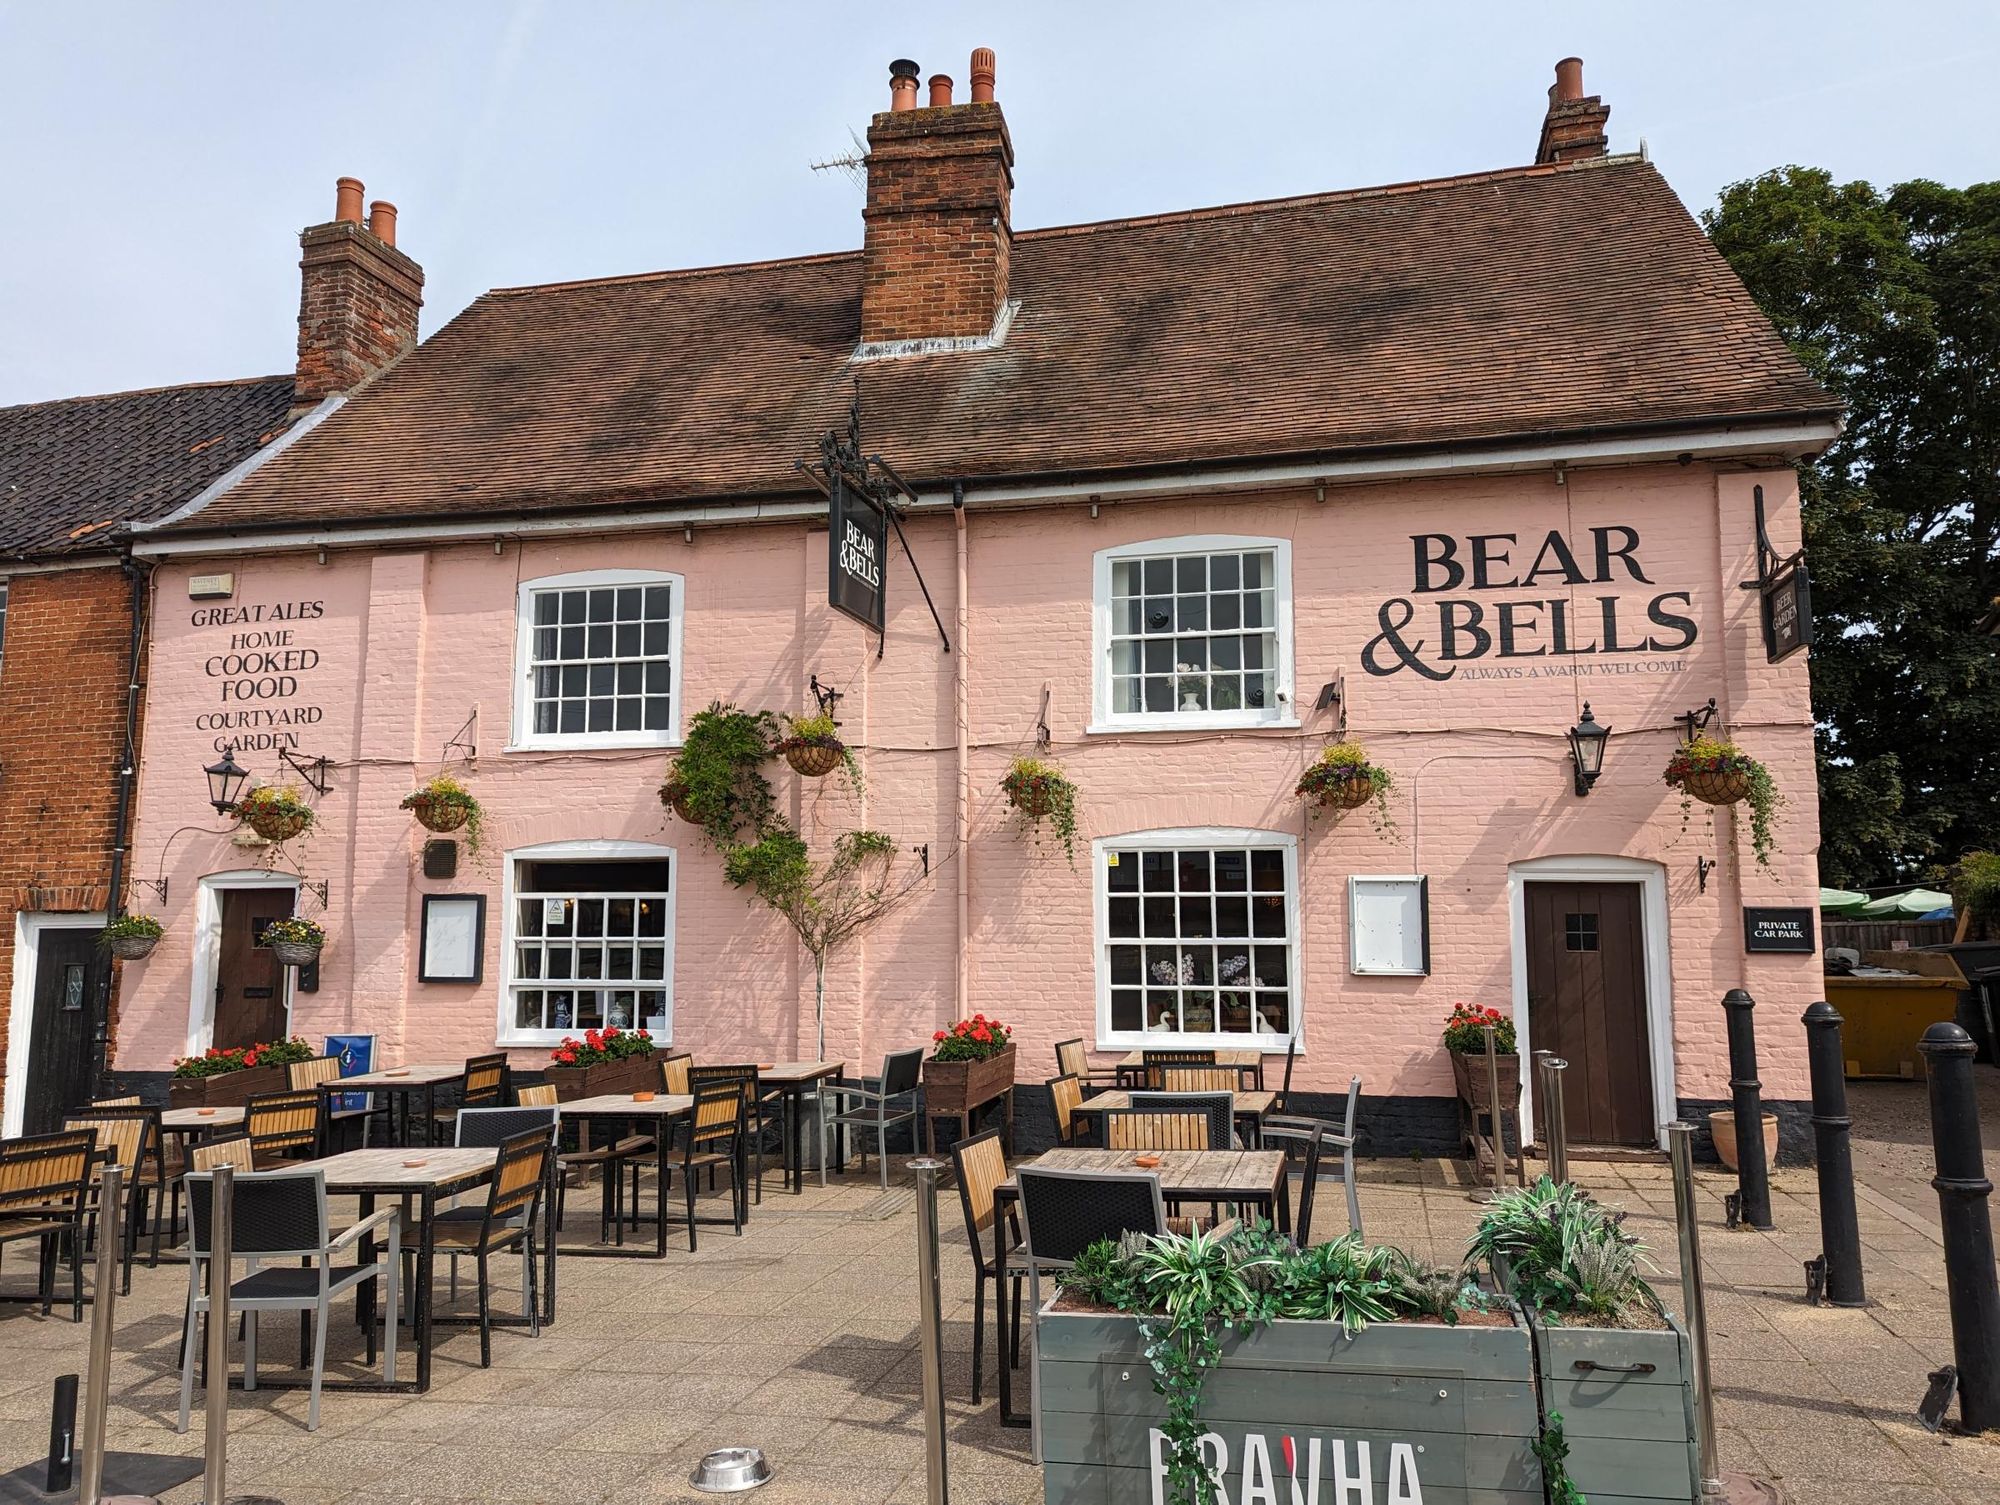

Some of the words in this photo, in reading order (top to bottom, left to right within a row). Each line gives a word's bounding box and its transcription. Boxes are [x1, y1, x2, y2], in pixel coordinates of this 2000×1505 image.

[846, 518, 876, 563] BEAR
[1408, 525, 1656, 594] BEAR
[191, 604, 267, 627] GREAT
[268, 600, 324, 621] ALES
[1776, 591, 1792, 612] BEER
[1773, 605, 1798, 631] GARDEN
[230, 629, 295, 650] HOME
[205, 649, 320, 677] COOKED
[1459, 667, 1524, 681] ALWAYS
[1526, 665, 1540, 679] A
[1542, 663, 1594, 677] WARM
[1599, 659, 1688, 676] WELCOME
[221, 676, 298, 702] FOOD
[195, 706, 323, 731] COURTYARD
[213, 731, 300, 753] GARDEN
[1754, 930, 1776, 938] CAR
[1778, 930, 1804, 938] PARK
[1758, 921, 1800, 930] PRIVATE
